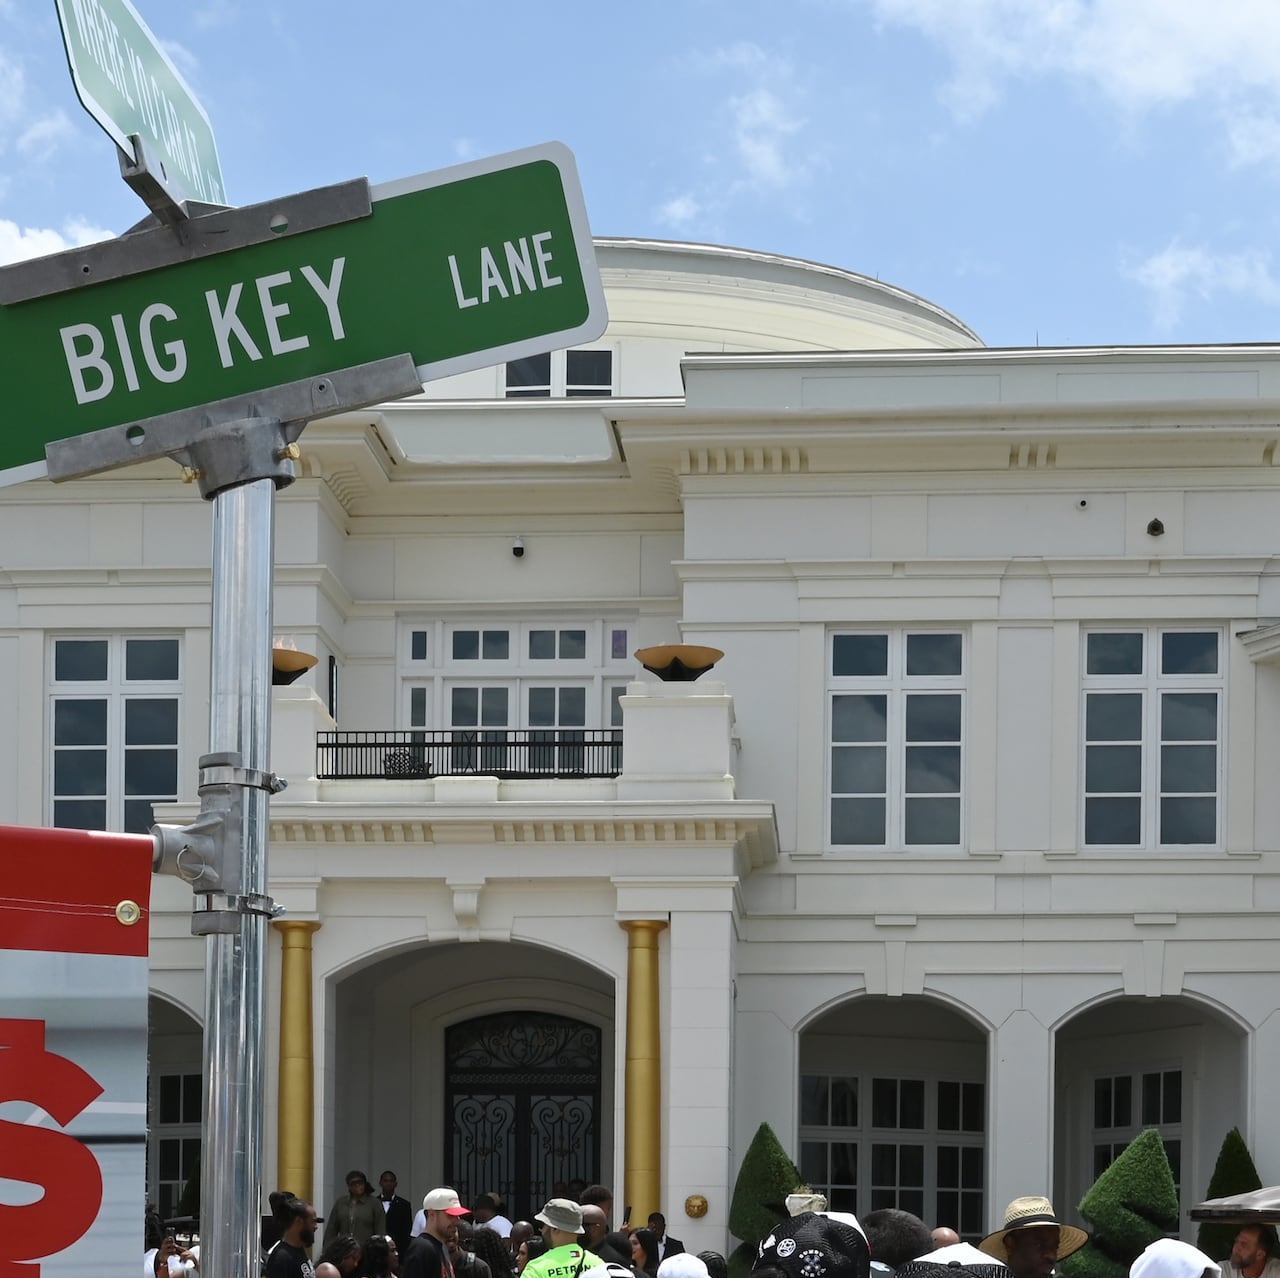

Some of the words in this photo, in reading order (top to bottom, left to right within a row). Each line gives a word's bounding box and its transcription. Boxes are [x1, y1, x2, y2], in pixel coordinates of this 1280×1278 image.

[60, 304, 188, 404] BIG
[206, 257, 347, 369] KEY
[447, 231, 563, 309] LANE
